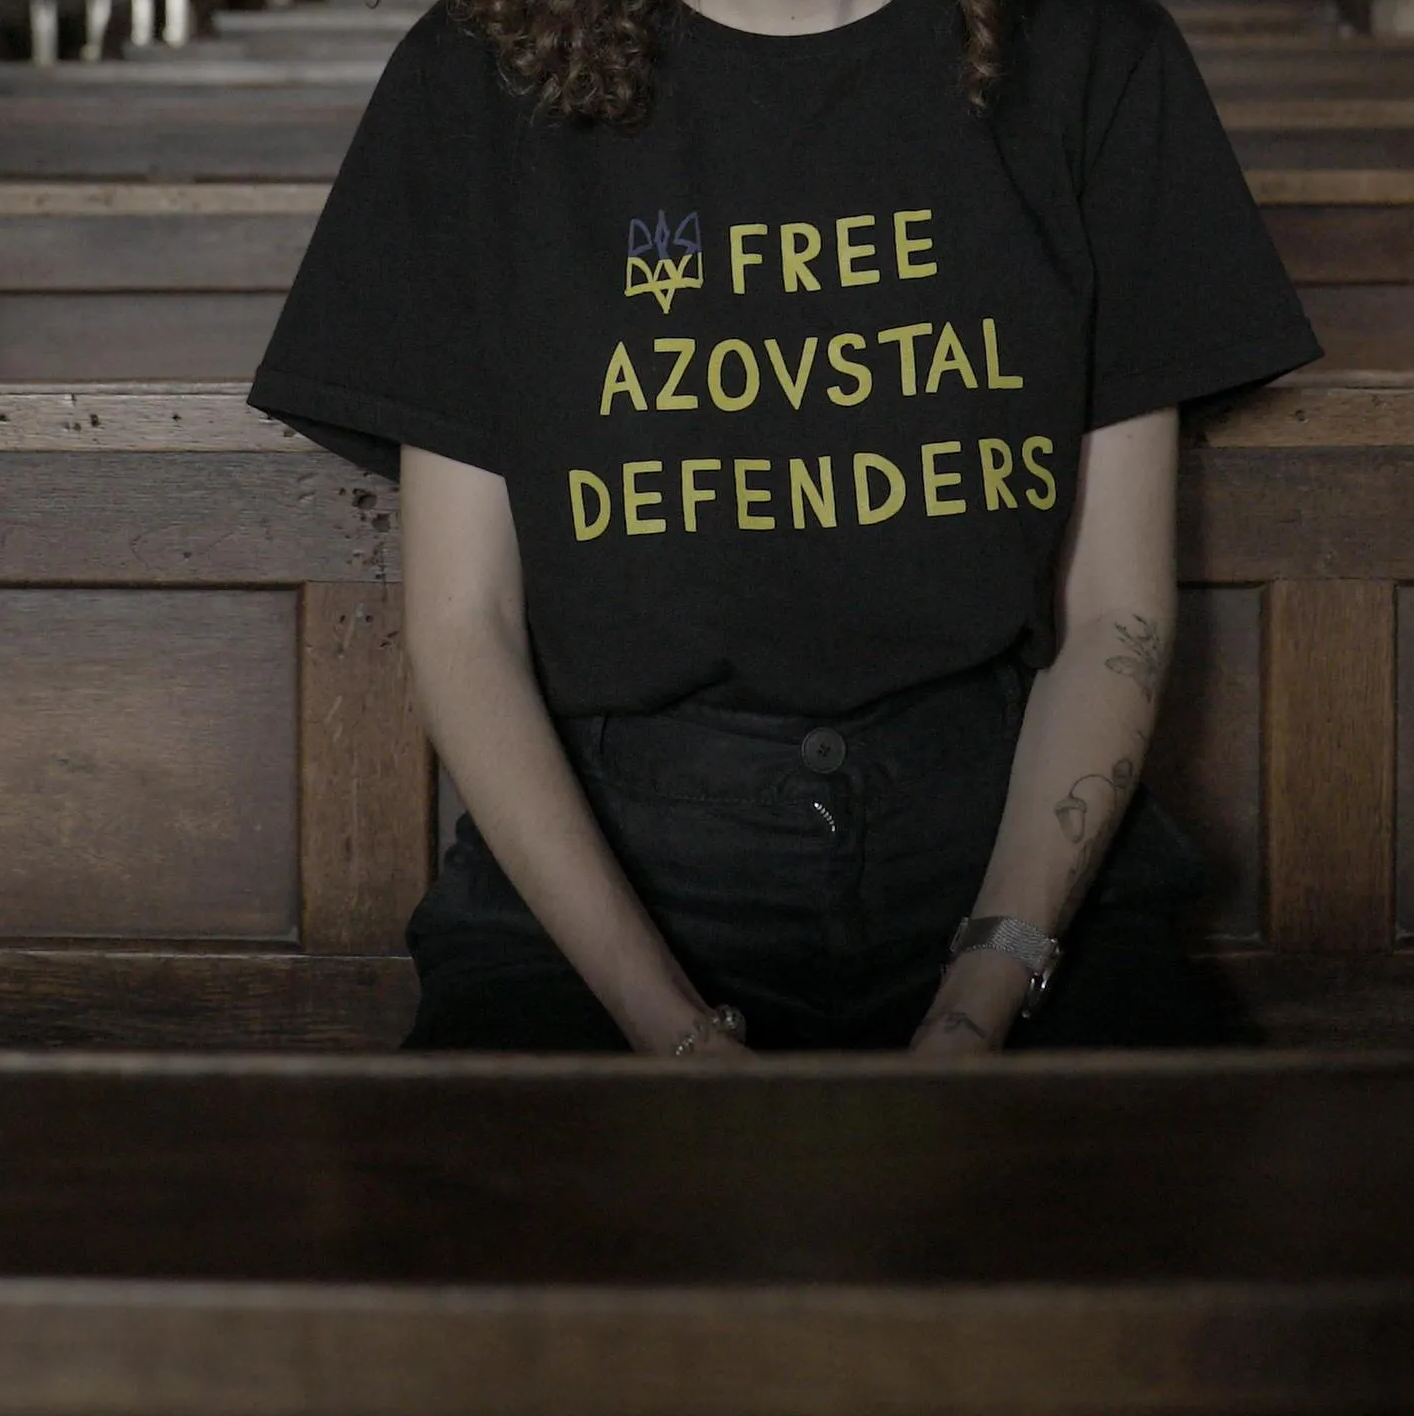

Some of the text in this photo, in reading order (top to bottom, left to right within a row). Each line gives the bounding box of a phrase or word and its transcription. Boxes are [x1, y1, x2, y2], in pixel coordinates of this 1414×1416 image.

[728, 208, 939, 295] FREE
[599, 317, 1025, 416] AZOVSTAL
[567, 435, 1057, 542] DEFENDERS
